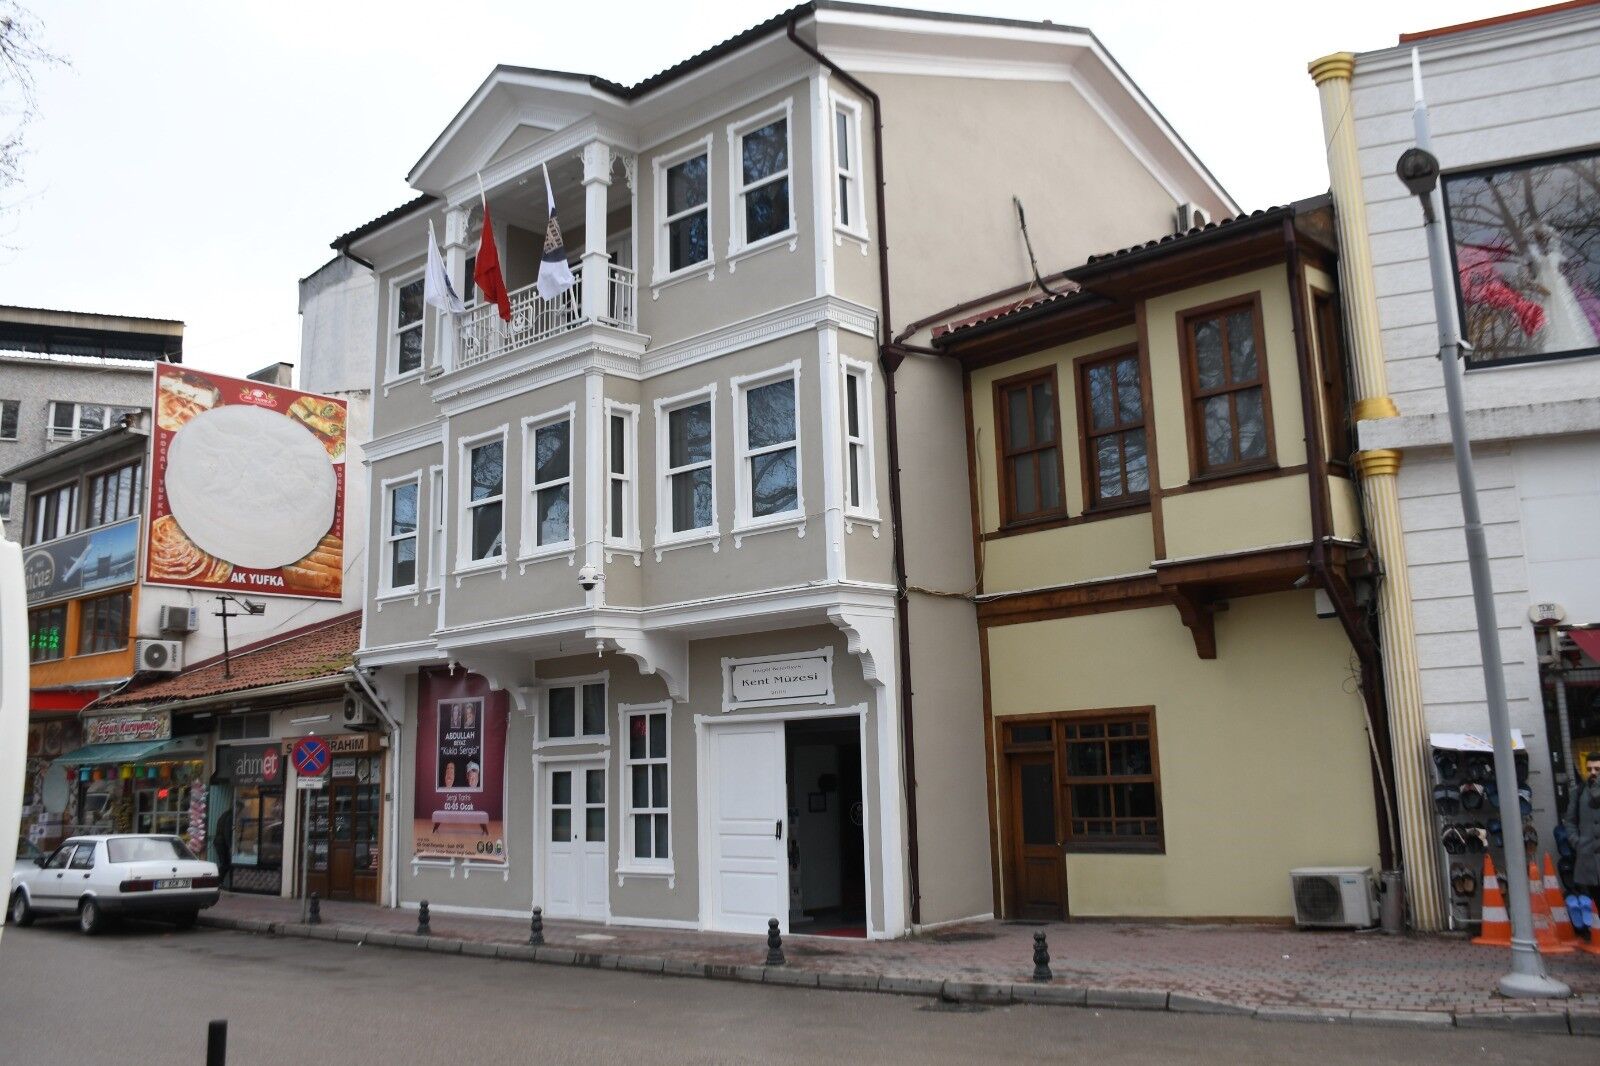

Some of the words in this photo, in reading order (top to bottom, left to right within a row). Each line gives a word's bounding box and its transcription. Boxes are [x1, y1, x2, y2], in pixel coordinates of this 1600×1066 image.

[230, 572, 247, 584] AK
[249, 573, 285, 588] YUFKA
[742, 677, 770, 688] Kent
[774, 672, 819, 684] Müzesi
[445, 731, 475, 740] ABDULLAH
[328, 738, 364, 752] RAHİM
[236, 753, 277, 775] ahmet
[460, 802, 474, 811] Ocak
